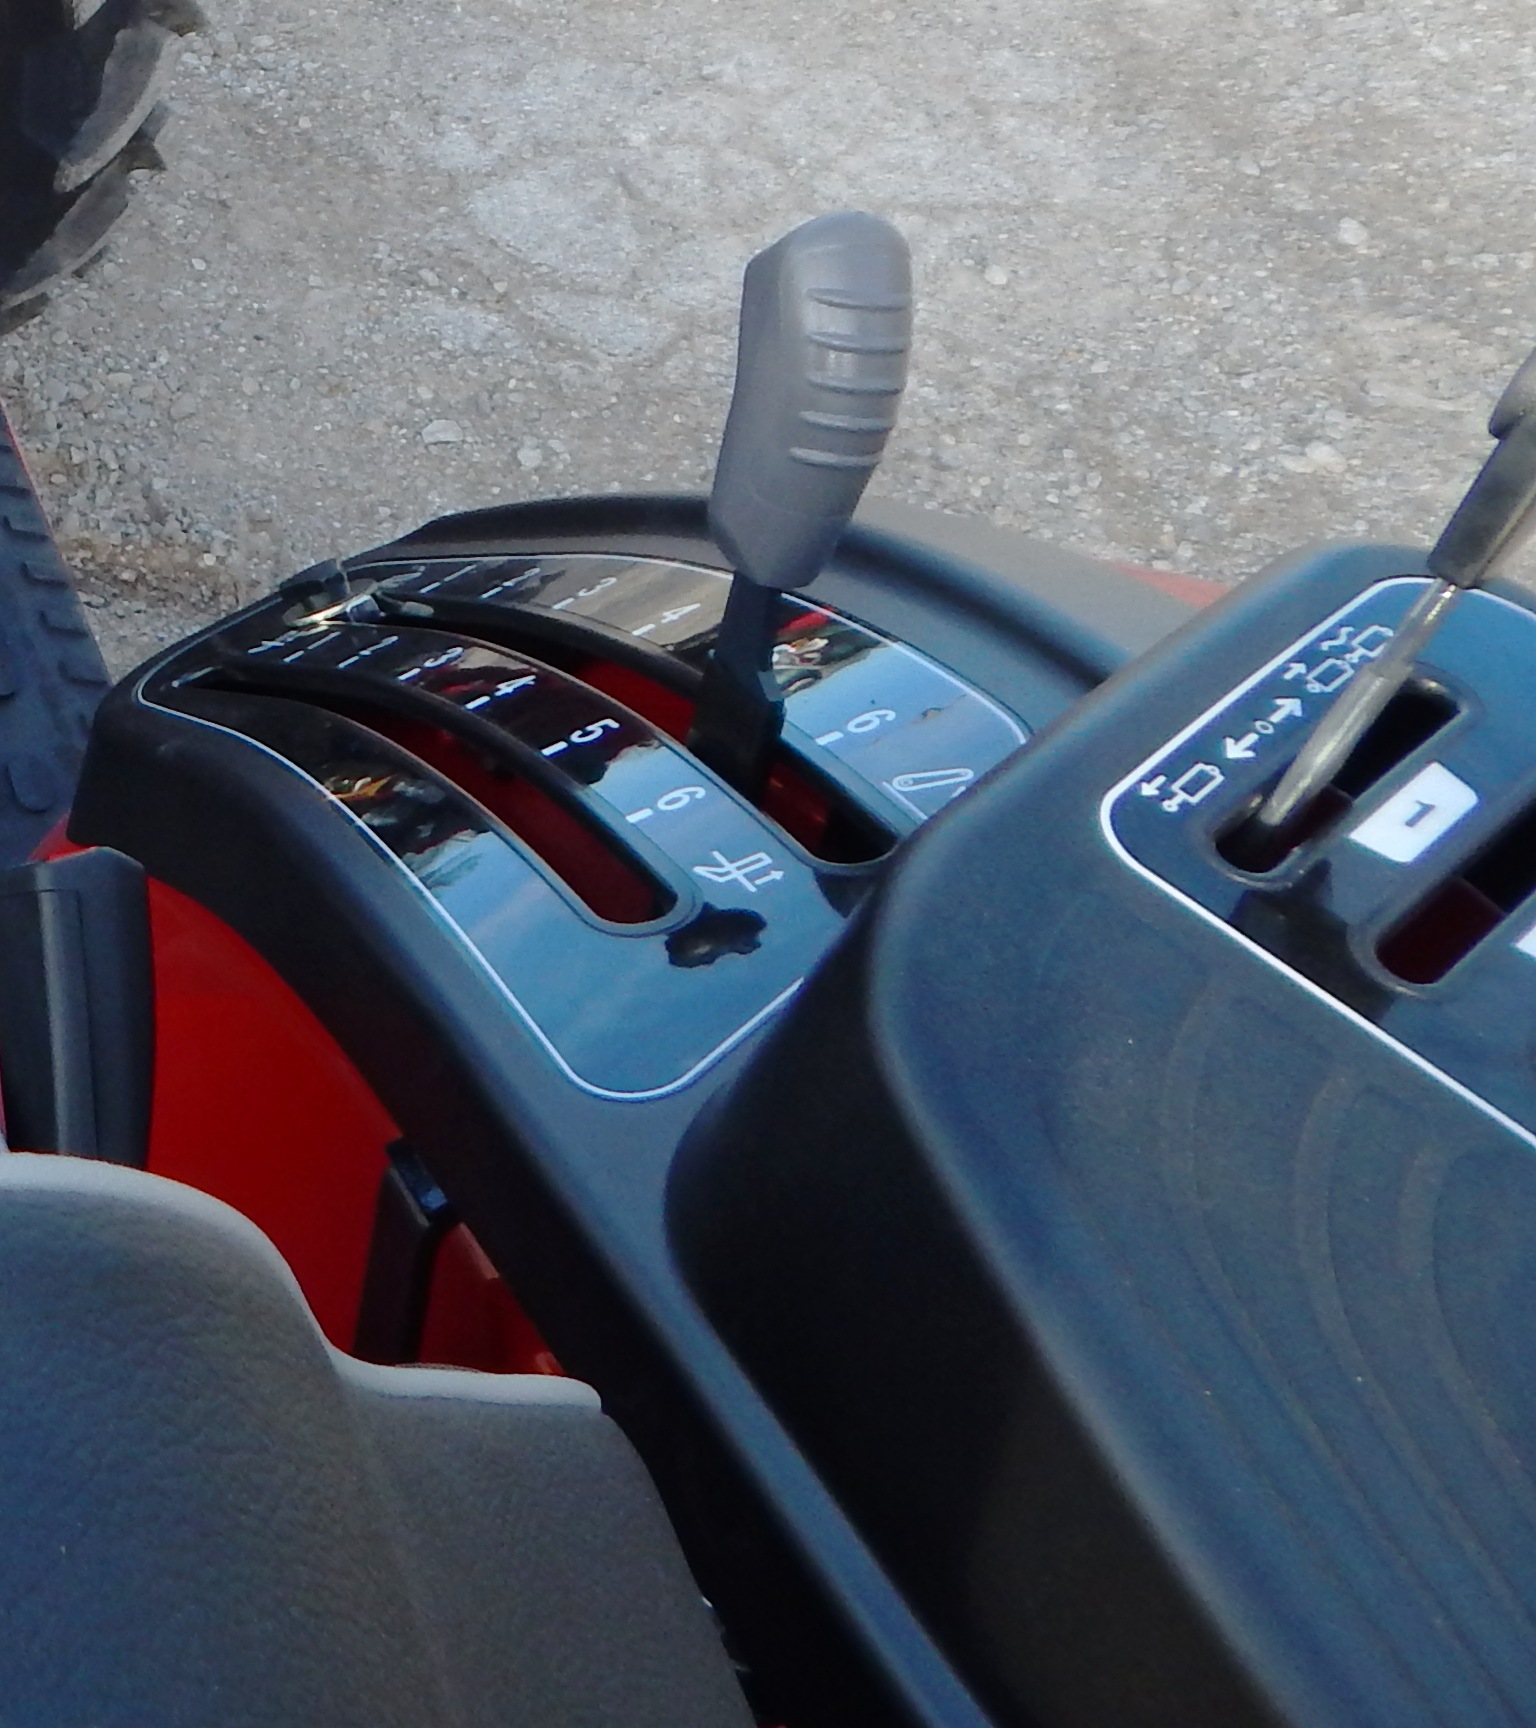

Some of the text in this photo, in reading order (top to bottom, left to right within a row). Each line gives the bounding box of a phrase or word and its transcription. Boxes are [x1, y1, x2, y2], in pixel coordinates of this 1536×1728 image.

[577, 576, 618, 600] 3
[660, 602, 702, 624] 4
[422, 645, 464, 669] 3
[493, 673, 537, 698] 4
[568, 717, 621, 745] 5
[845, 708, 897, 735] 6
[656, 785, 708, 812] 6
[1404, 800, 1436, 829] 1
